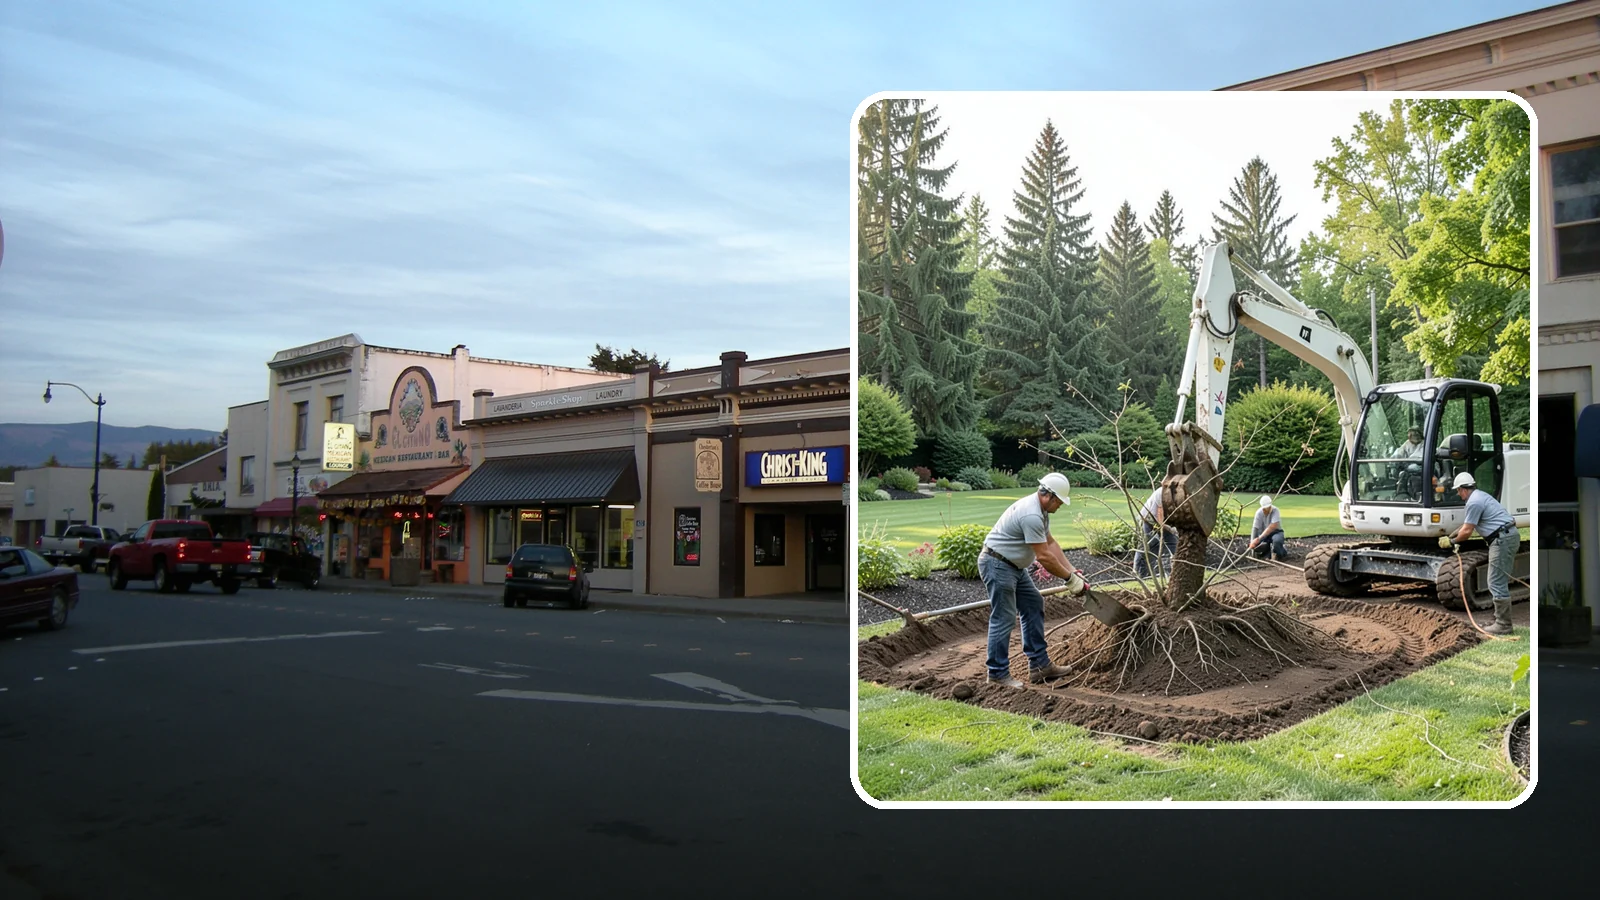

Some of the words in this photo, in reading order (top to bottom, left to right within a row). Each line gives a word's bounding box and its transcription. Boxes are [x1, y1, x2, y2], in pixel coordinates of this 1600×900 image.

[595, 389, 623, 400] LAUNDRY
[494, 402, 522, 413] LAVANDERIA
[373, 455, 396, 464] MEXICAN
[397, 452, 434, 462] RESTAURANT
[438, 450, 450, 459] BAR
[760, 452, 797, 478] CHRIST
[799, 450, 828, 477] KING
[696, 480, 709, 489] Coffee
